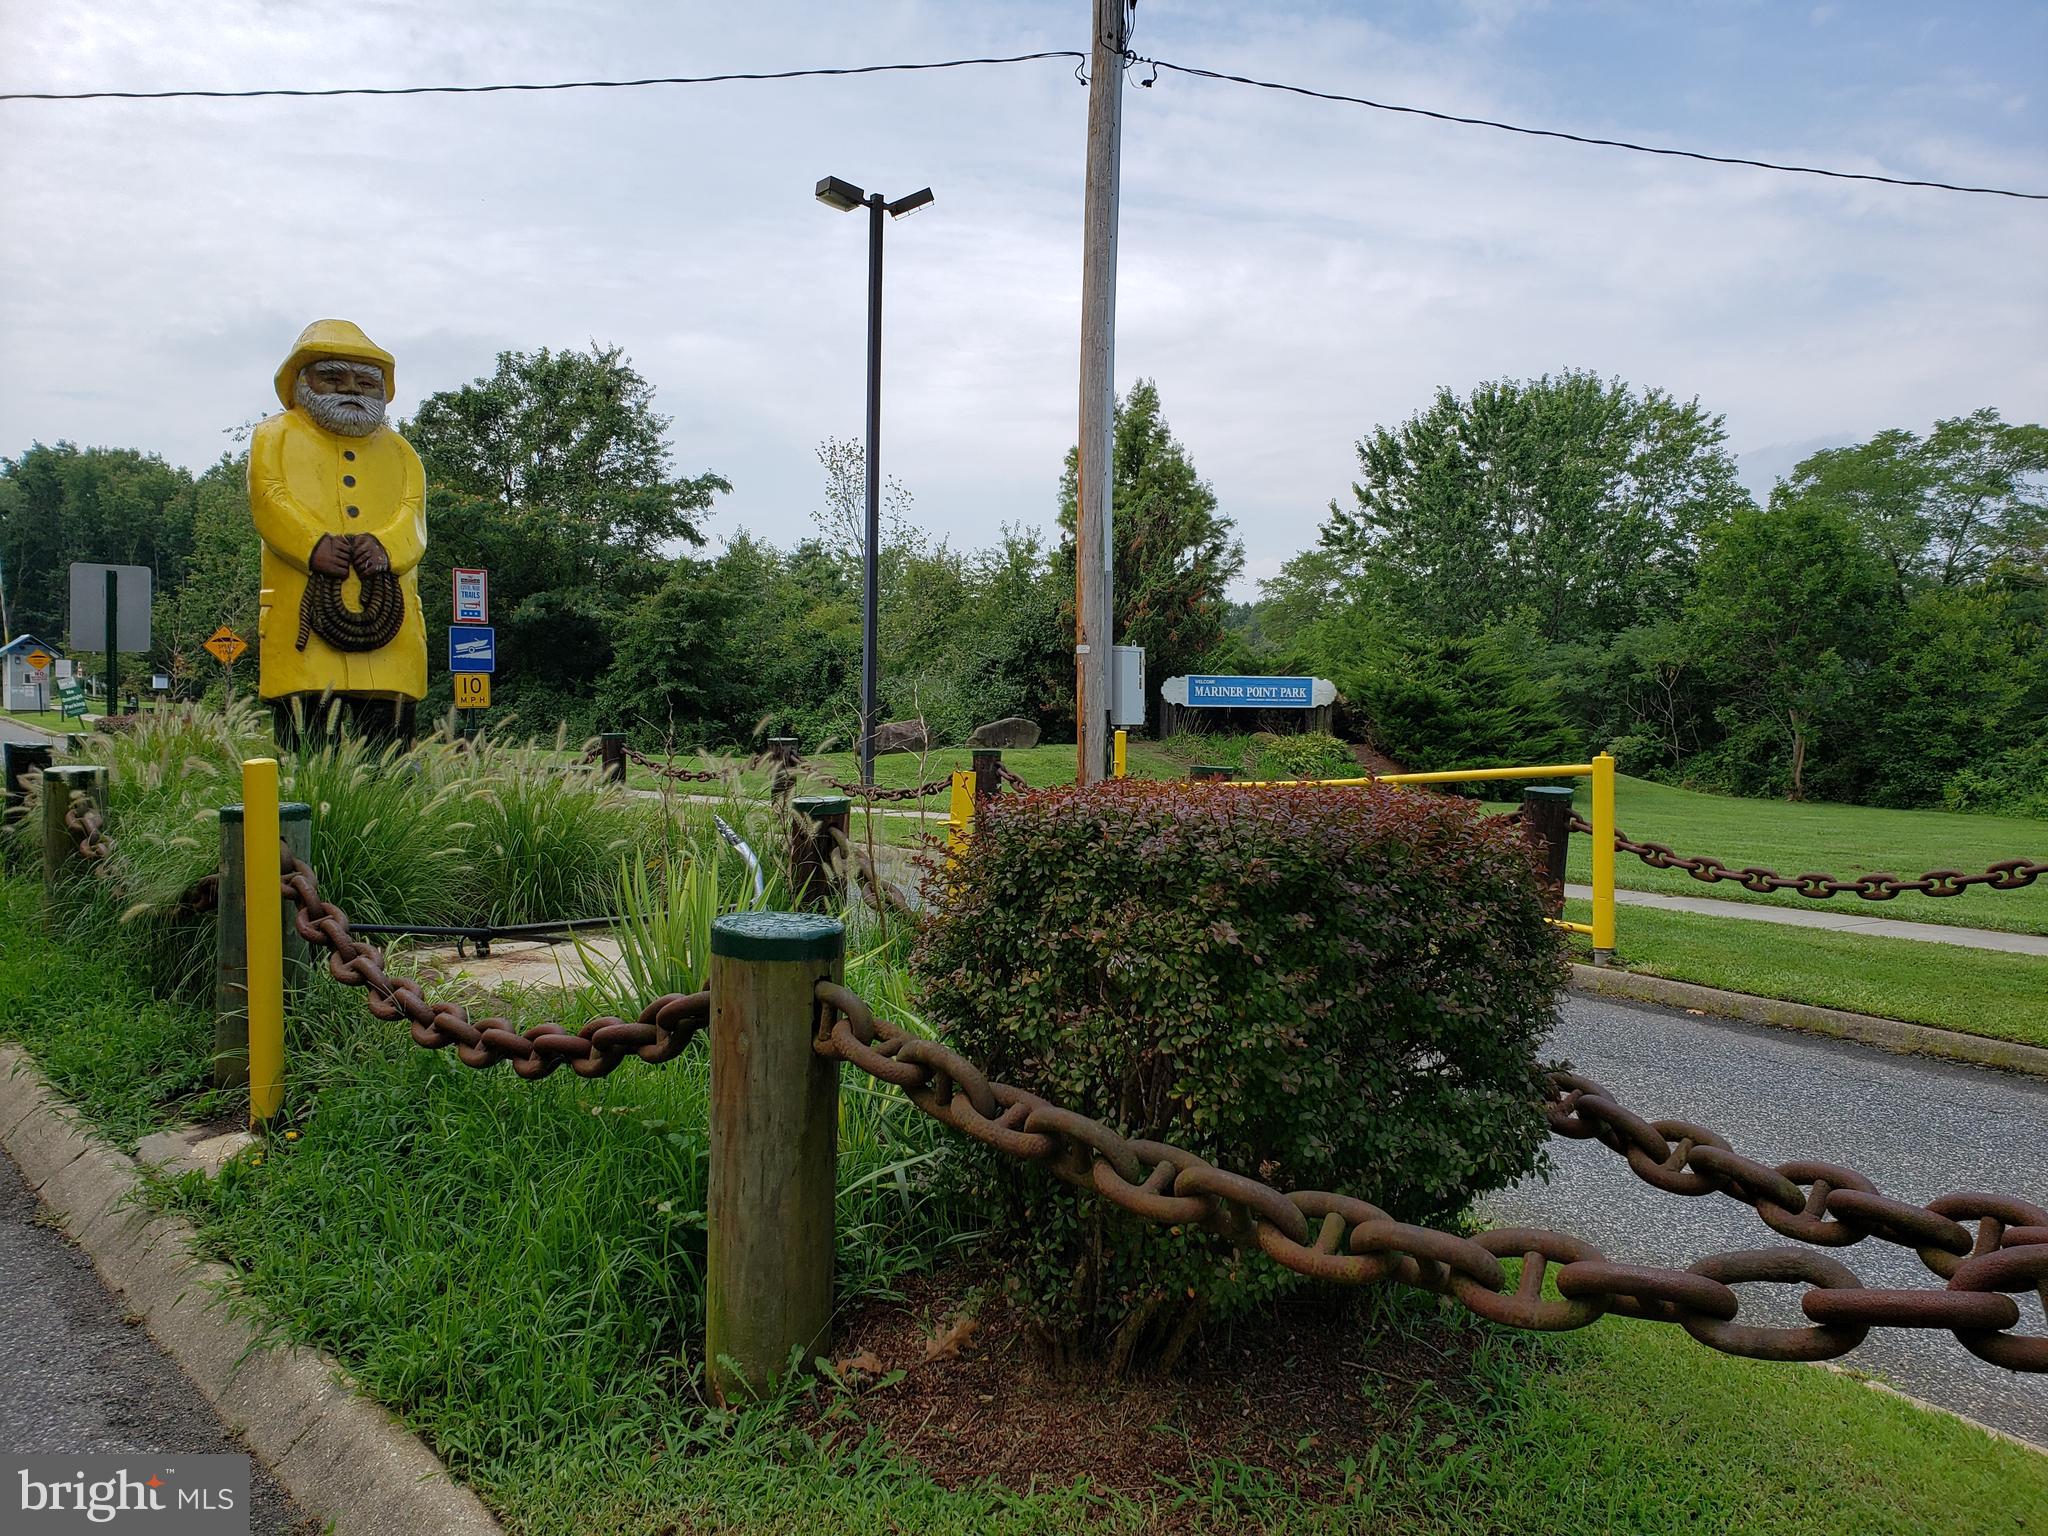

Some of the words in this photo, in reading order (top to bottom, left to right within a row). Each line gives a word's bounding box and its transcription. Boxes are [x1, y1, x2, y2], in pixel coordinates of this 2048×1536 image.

[463, 677, 481, 694] 10
[1194, 686, 1243, 697] MARINER
[1246, 687, 1278, 697] POINT
[1280, 687, 1306, 698] PARK
